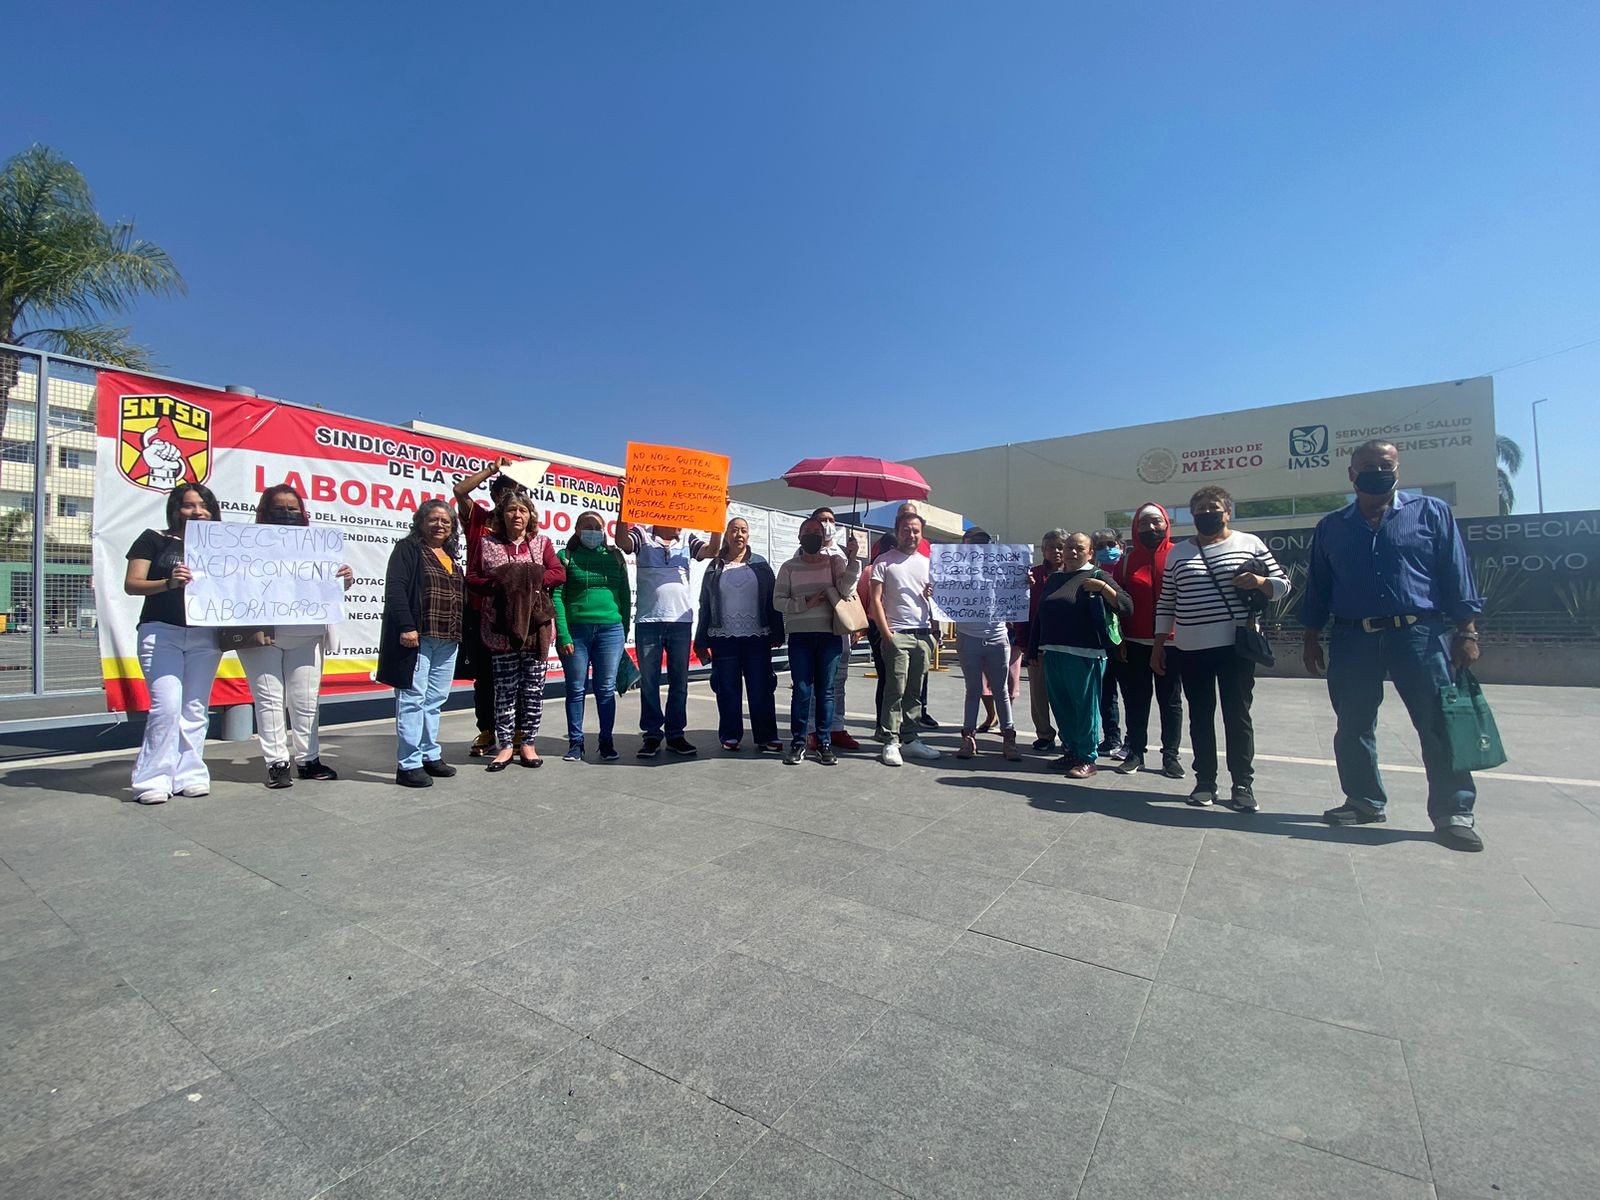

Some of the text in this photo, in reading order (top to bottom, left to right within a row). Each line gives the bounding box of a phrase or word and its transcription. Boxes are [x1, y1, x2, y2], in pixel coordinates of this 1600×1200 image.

[123, 398, 206, 428] SNTSA
[1335, 417, 1472, 439] SERVICIOS DE SALUD
[1182, 443, 1263, 459] GOBIERNO DE
[1397, 436, 1472, 452] ENESTAR
[316, 428, 435, 463] SINDICATO
[559, 476, 619, 498] TRABAJA
[633, 452, 711, 468] NO NOS QUITEN
[1182, 455, 1263, 474] MÉXICO
[1288, 454, 1330, 470] IMSS
[632, 463, 721, 481] NUESTROS DERECHOS
[389, 461, 414, 479] DE
[421, 467, 445, 484] LA
[563, 493, 578, 506] DE
[628, 475, 723, 493] NI NUESTRA ESPERANZA
[644, 487, 668, 497] VIDA
[672, 491, 723, 503] NECESITAMOS
[627, 499, 666, 509] NUESTROS
[668, 502, 708, 514] ESTUDIOS
[315, 512, 336, 522] DEL
[340, 515, 393, 528] HOSPITAL
[628, 508, 695, 523] MEDICAMENTOS
[1467, 519, 1600, 541] ESPECIAL
[940, 551, 967, 562] SOY
[1485, 553, 1588, 571] APOYO
[261, 579, 272, 595] Y
[348, 612, 383, 620] NEGAT
[344, 647, 379, 656] TRABA
